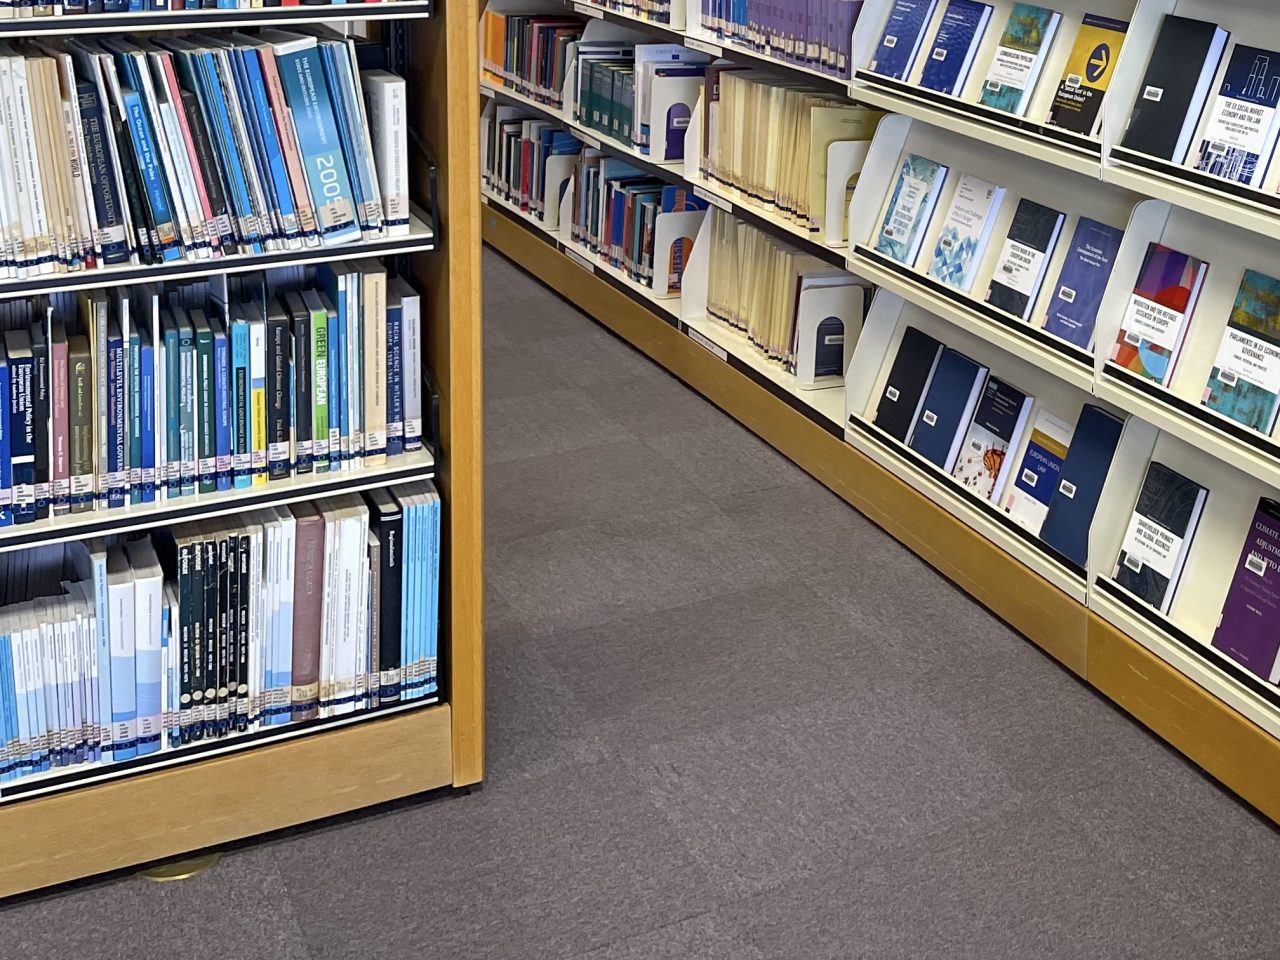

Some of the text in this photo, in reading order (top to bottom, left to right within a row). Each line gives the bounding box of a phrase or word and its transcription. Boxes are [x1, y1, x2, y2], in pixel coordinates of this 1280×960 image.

[132, 106, 156, 181] The Ocean and the Poles
[316, 327, 327, 405] GREEN EUROPEAN
